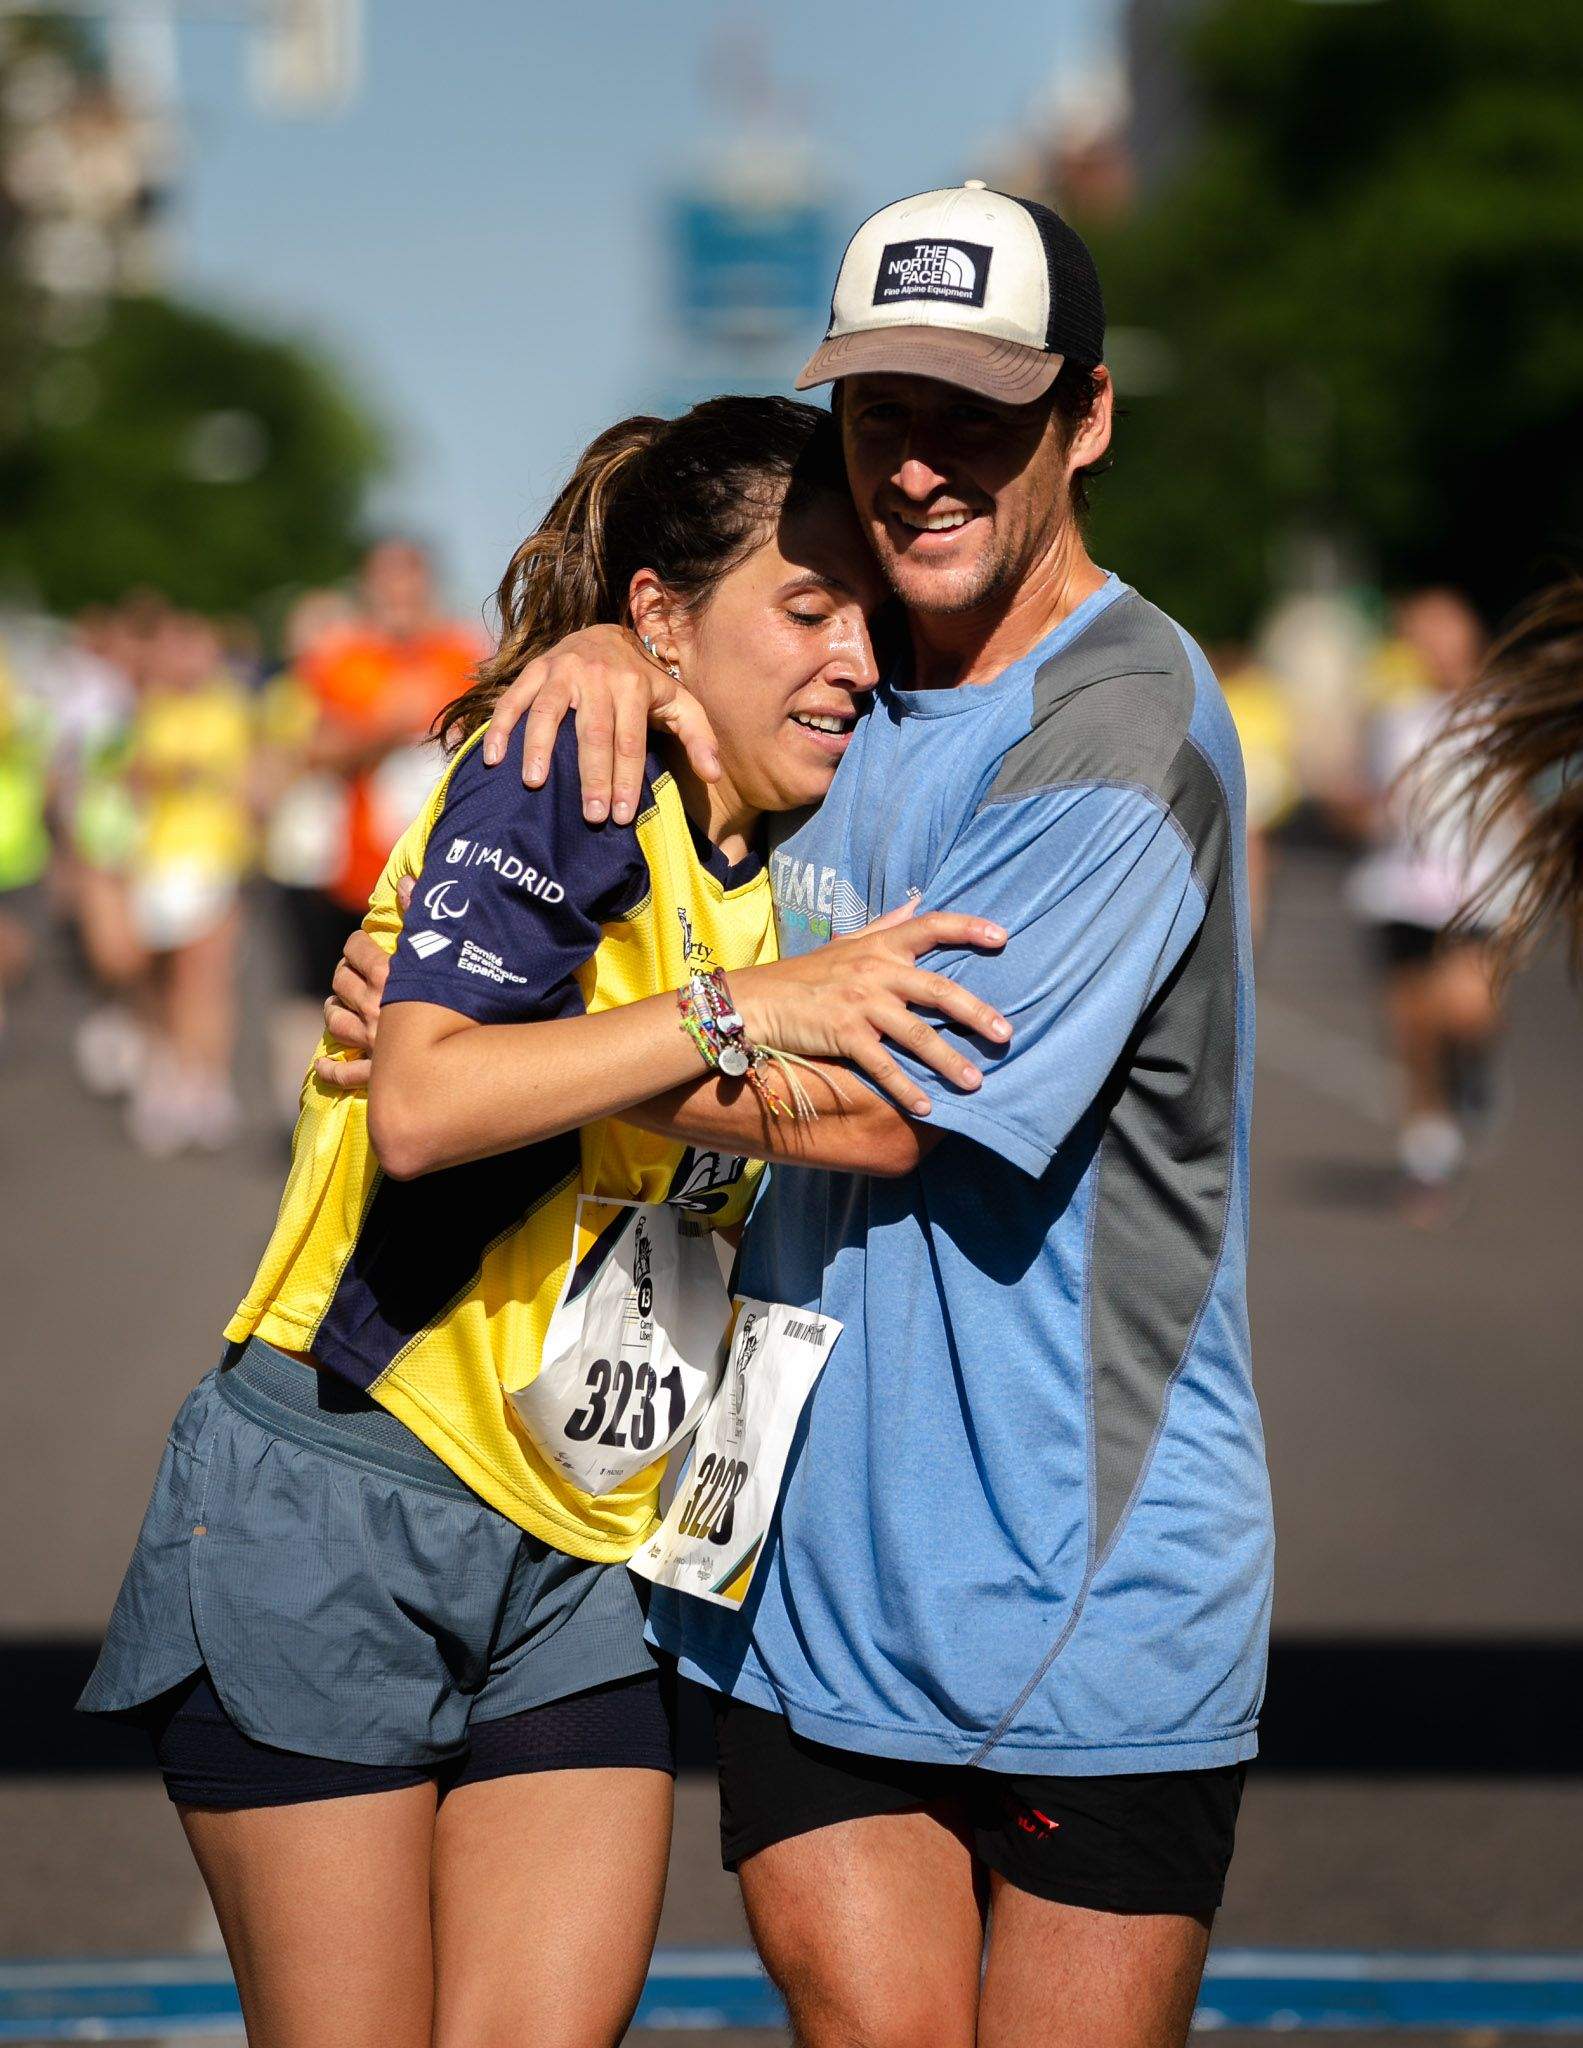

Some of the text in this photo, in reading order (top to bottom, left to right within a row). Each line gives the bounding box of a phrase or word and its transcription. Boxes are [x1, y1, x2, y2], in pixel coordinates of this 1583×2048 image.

[914, 245, 947, 259] THE
[888, 258, 945, 275] NORTH
[900, 270, 942, 286] FACE
[883, 285, 973, 299] Fine Alpine Equipment
[463, 940, 504, 967] Comité
[641, 1288, 651, 1308] 13
[564, 1358, 686, 1451] 3231
